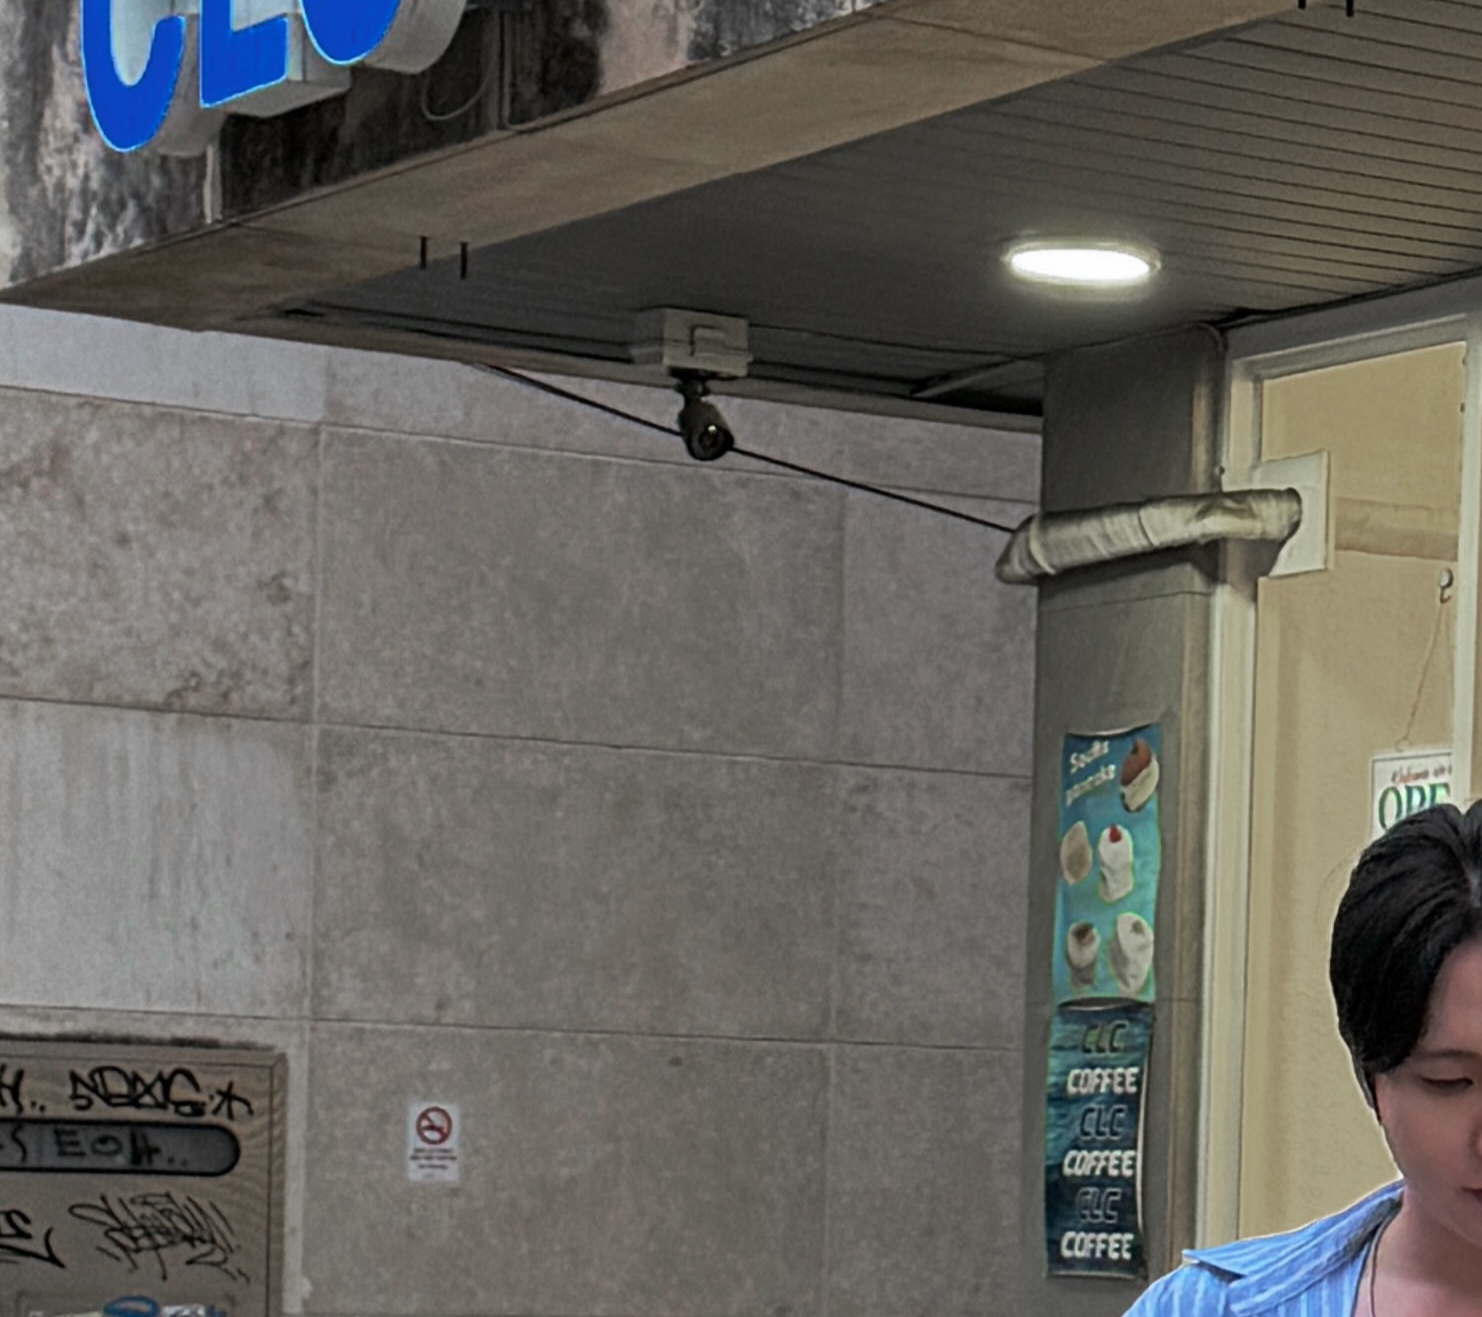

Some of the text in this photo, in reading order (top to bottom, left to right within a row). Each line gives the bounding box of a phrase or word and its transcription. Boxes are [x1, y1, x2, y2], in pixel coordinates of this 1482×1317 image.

[1081, 1020, 1129, 1056] CLC
[1066, 1066, 1141, 1095] COFFEE
[1079, 1104, 1128, 1141] CLC
[1062, 1150, 1137, 1177] COFFEE
[1076, 1186, 1122, 1223] CLC
[1060, 1231, 1135, 1261] COFFEE
